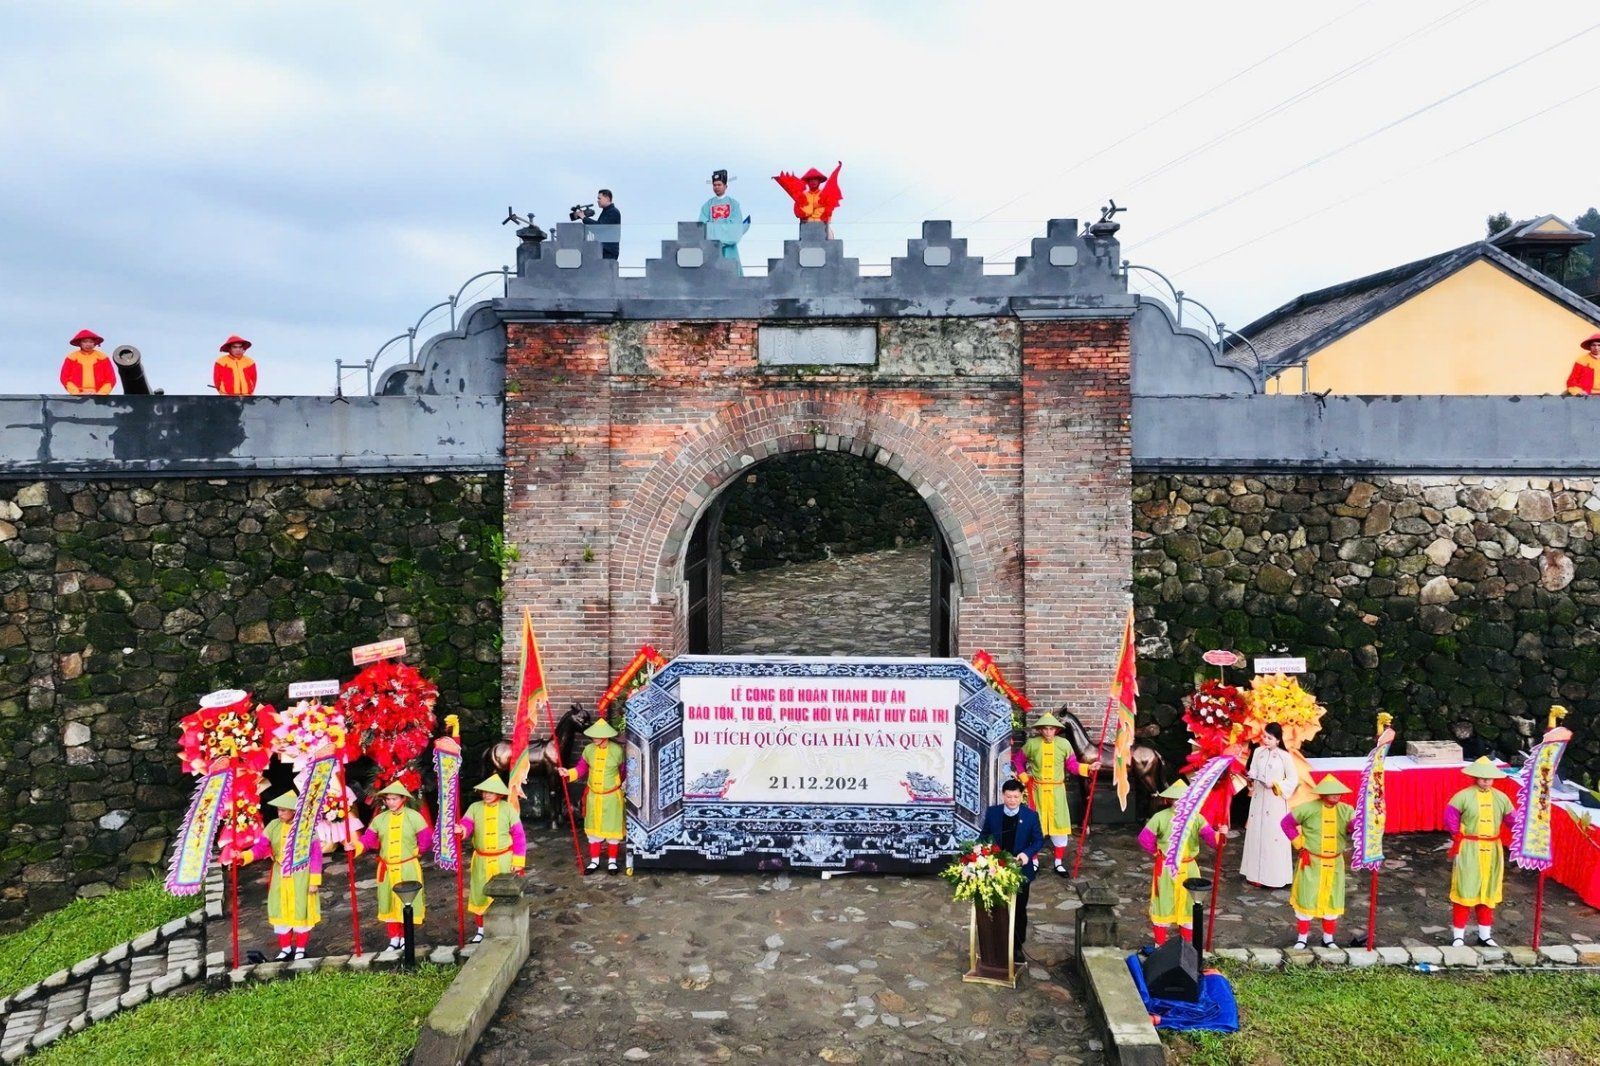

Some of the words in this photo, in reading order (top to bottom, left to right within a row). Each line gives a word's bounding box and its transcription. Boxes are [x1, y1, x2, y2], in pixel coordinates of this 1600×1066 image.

[745, 686, 775, 702] CÔNG
[798, 687, 828, 703] HOÀN
[832, 688, 868, 704] THÀNH
[741, 707, 754, 722] TU
[780, 707, 809, 725] PHỤC
[853, 706, 881, 723] PHÁT
[884, 708, 906, 723] HUY
[909, 707, 928, 723] GIÁ
[932, 708, 950, 725] TRỊ
[694, 731, 709, 745] DI
[713, 727, 751, 746] TÍCH
[754, 726, 798, 748] QUỐC
[801, 733, 829, 746] GIA
[833, 729, 860, 747] HẢI
[864, 729, 896, 747] VÂN
[899, 734, 943, 750] QUAN
[768, 776, 869, 790] 21.12.2024
